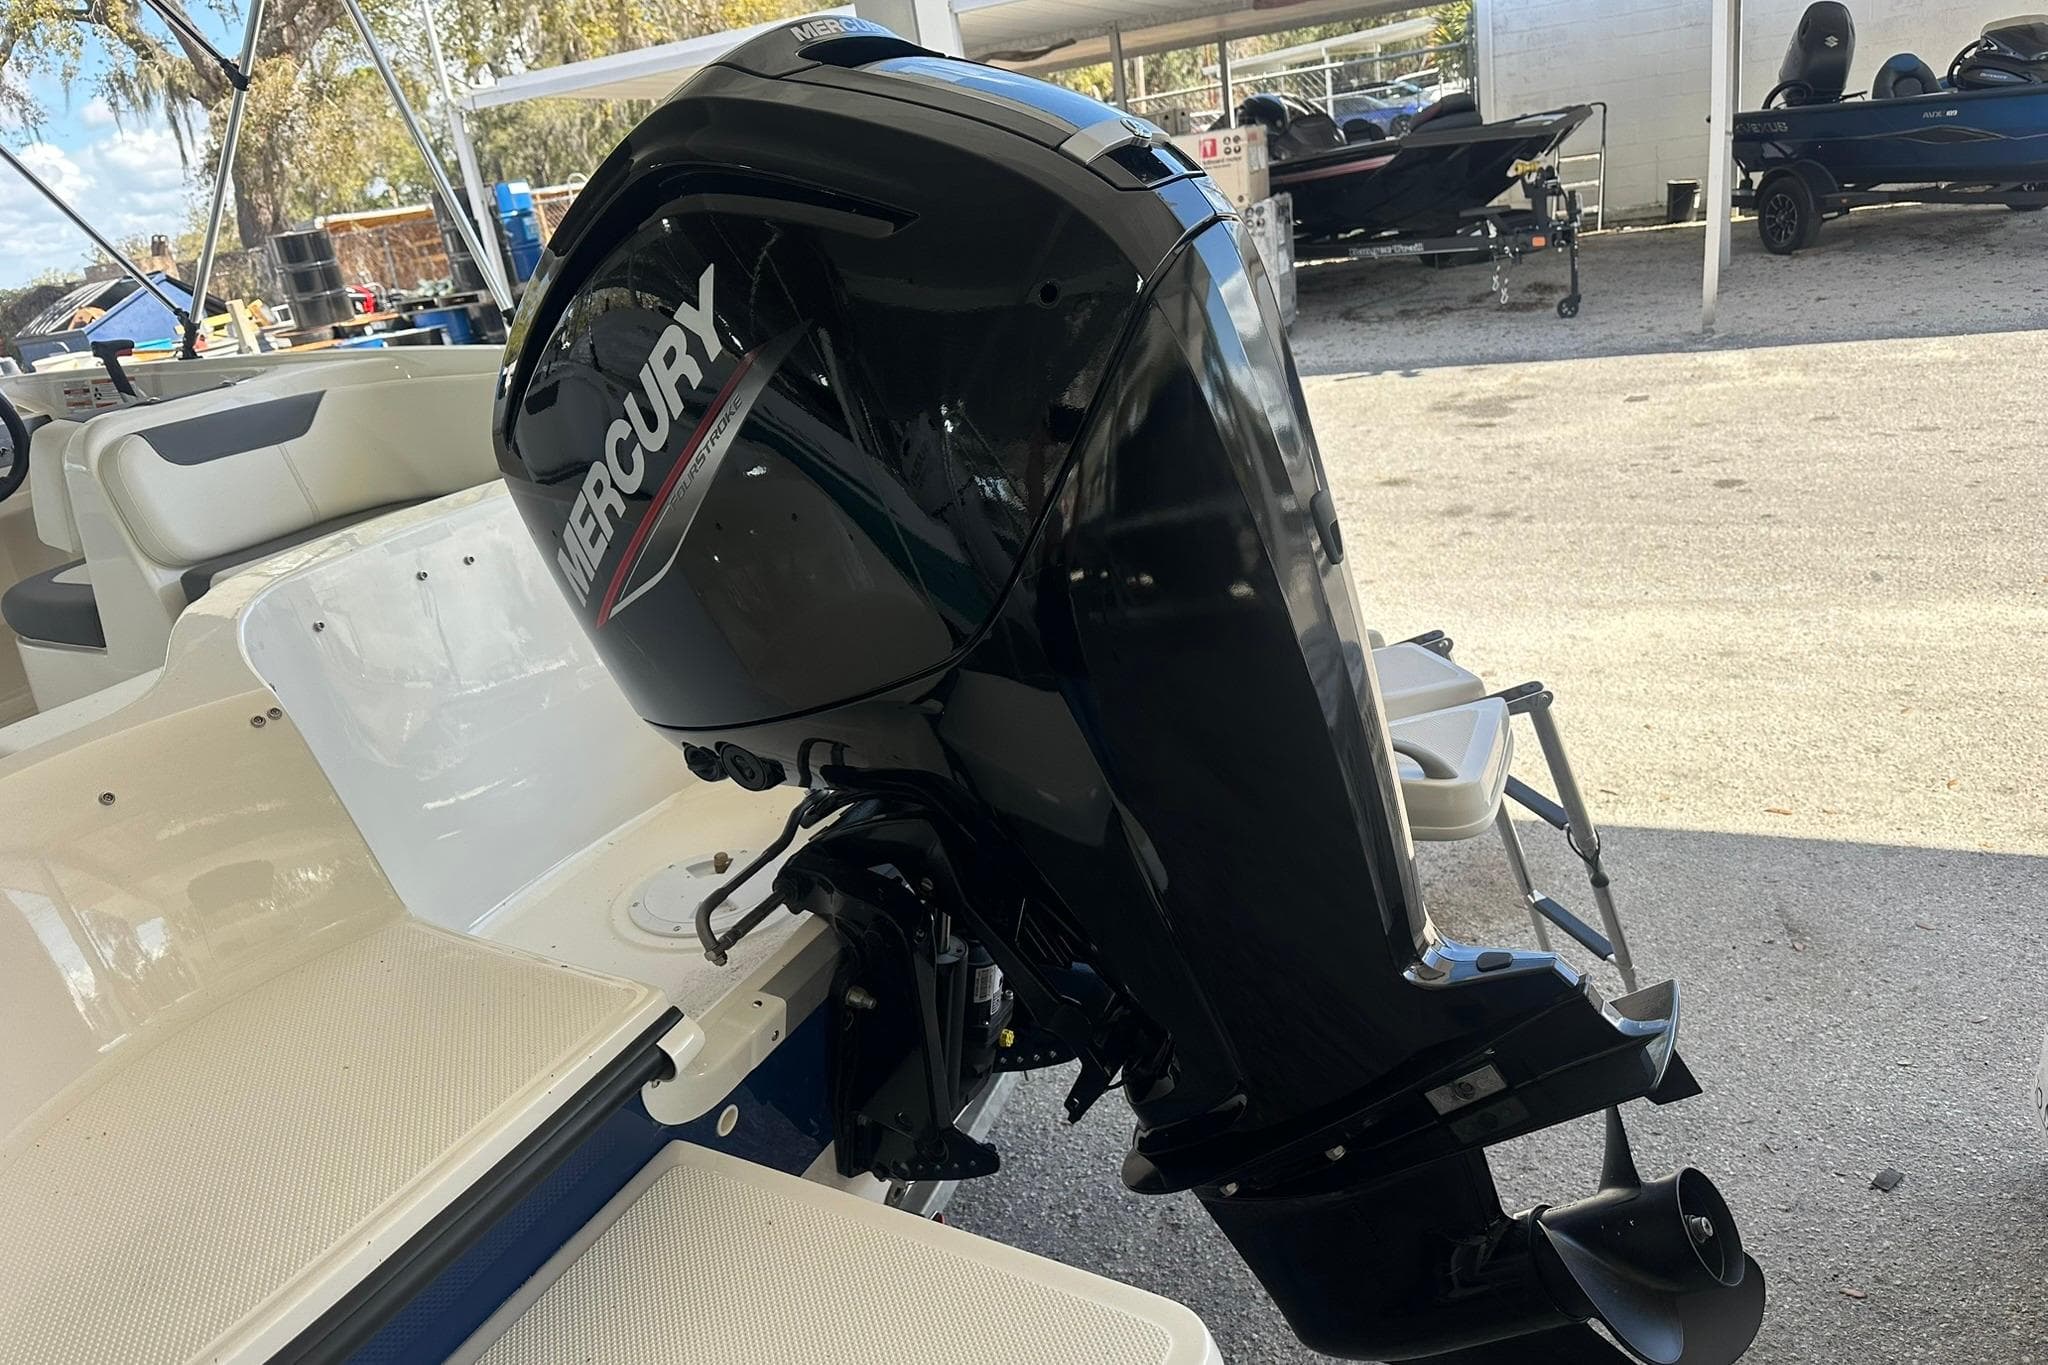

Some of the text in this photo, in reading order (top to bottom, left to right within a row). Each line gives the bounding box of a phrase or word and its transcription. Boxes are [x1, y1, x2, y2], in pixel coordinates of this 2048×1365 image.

[790, 19, 888, 42] MERCUR
[557, 263, 723, 607] MERCURY
[669, 392, 742, 511] FOURSTROKE
